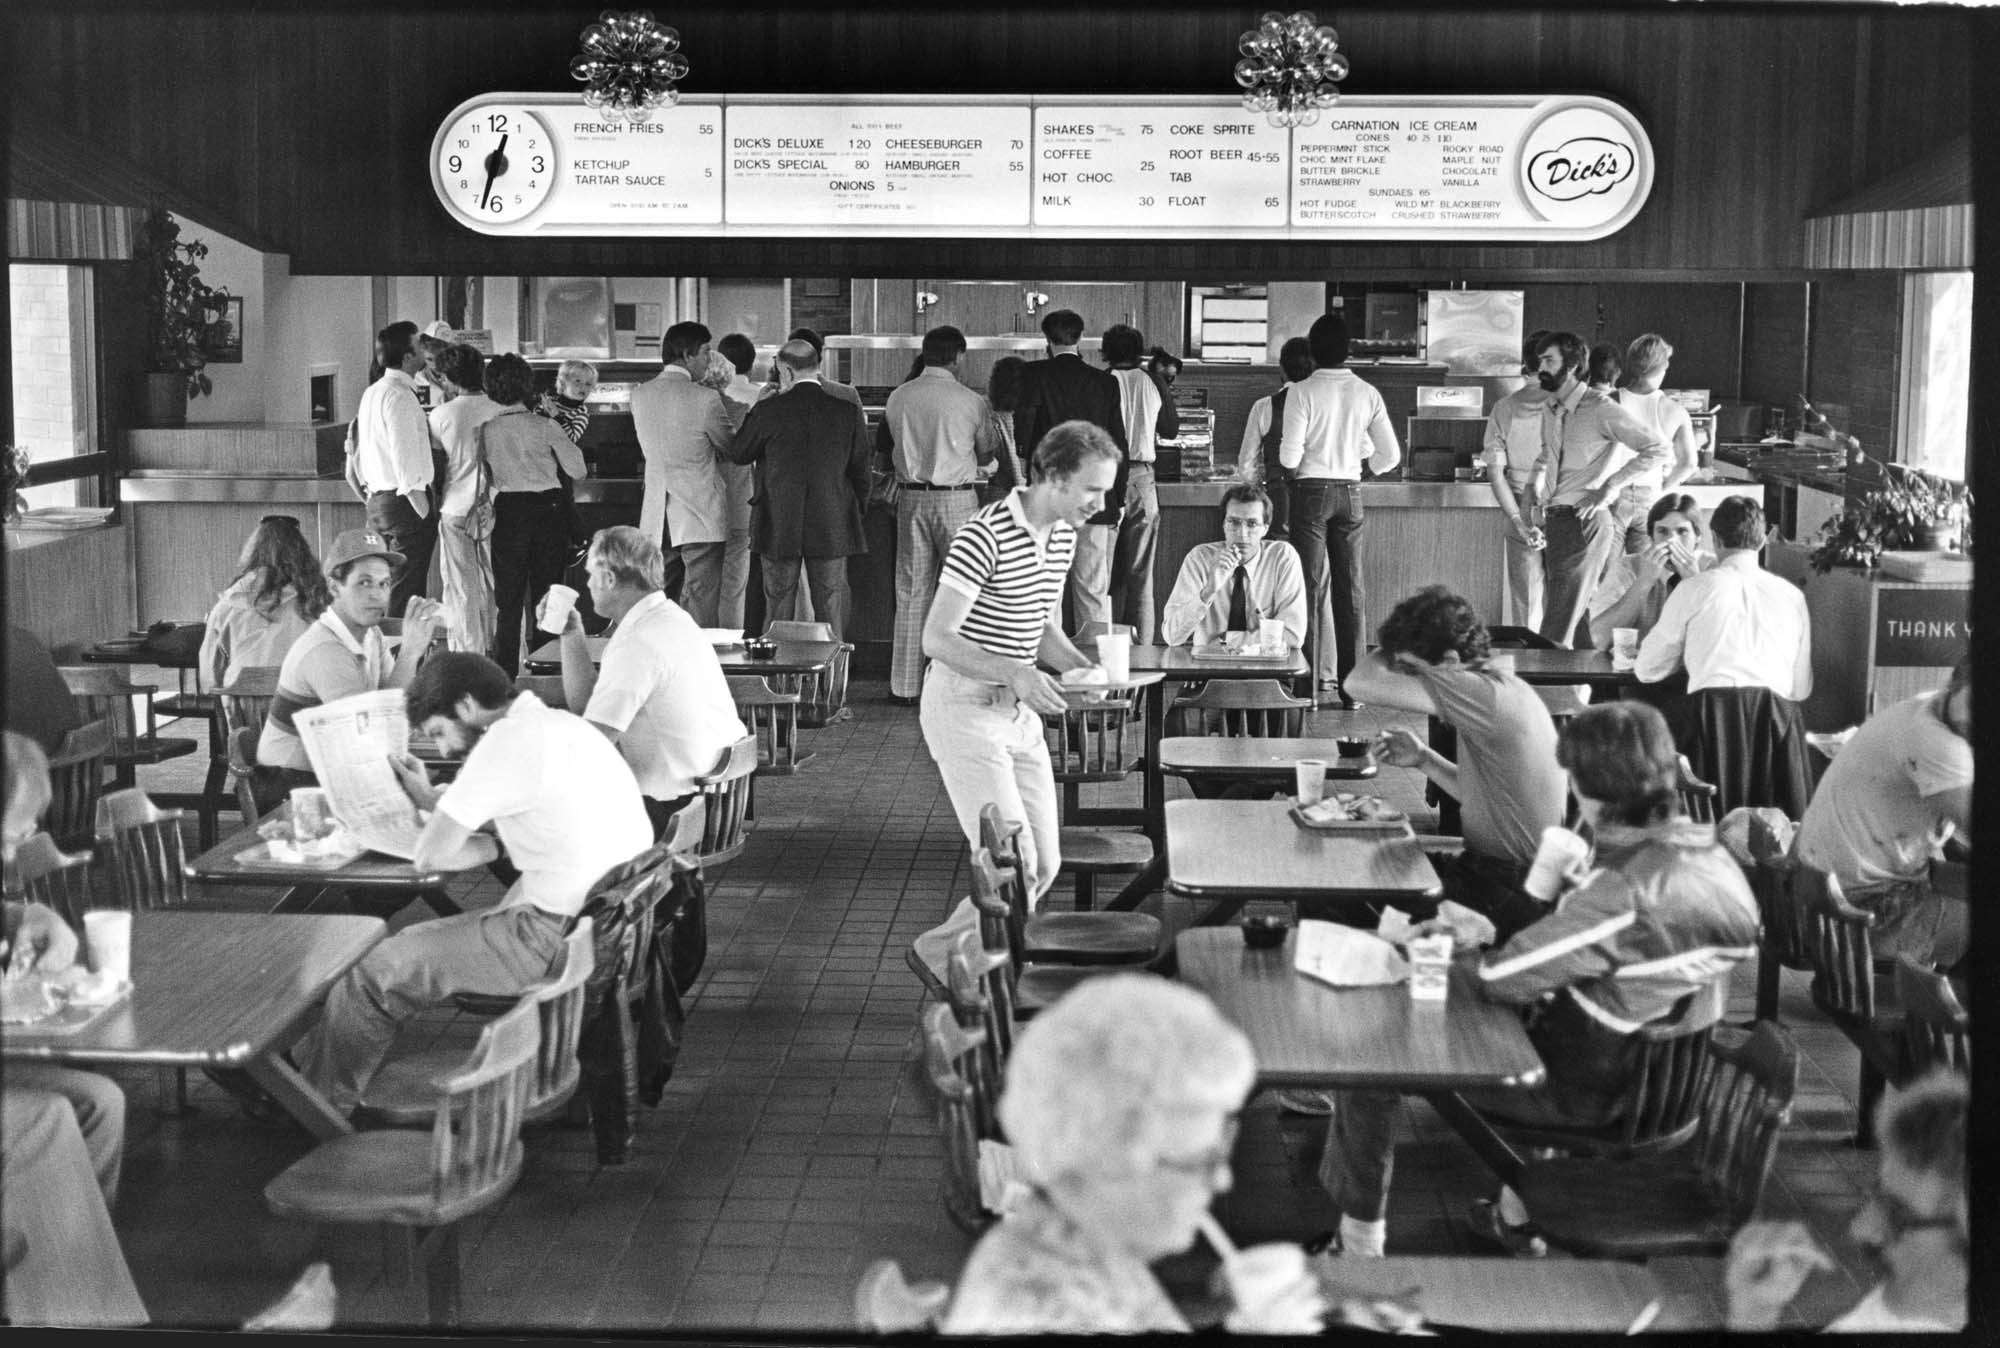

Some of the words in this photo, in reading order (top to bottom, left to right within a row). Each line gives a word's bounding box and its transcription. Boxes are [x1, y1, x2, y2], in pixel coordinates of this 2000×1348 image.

[471, 123, 481, 134] 11
[487, 114, 508, 133] 12
[517, 123, 521, 134] 1
[574, 122, 622, 134] FRENCH
[629, 122, 665, 134] FRIES
[699, 124, 713, 135] 55
[1331, 120, 1400, 131] CARNATION
[1409, 120, 1429, 131] ICE
[1433, 120, 1477, 131] CREAM
[1043, 124, 1095, 135] SHAKES
[1140, 124, 1154, 135] 75
[1169, 124, 1204, 135] COKE
[1213, 124, 1255, 135] SPRITE
[734, 137, 771, 149] DICK'S
[777, 138, 824, 149] DELUXE
[1355, 133, 1390, 142] CONES
[458, 139, 470, 149] 10
[528, 139, 536, 149] 2
[885, 139, 983, 149] CHEESEBURGER
[1010, 140, 1024, 150] 70
[1300, 144, 1357, 153] PEPPERMINT
[1363, 145, 1391, 153] STICK
[1442, 145, 1473, 153] ROCKY
[1479, 145, 1504, 153] ROAD
[1043, 149, 1092, 160] COFFEE
[1169, 149, 1202, 160] ROOT
[1210, 149, 1243, 160] BEER
[1299, 155, 1326, 164] CHOC
[1330, 155, 1353, 164] MINT
[1356, 155, 1386, 164] FLAKE
[1442, 156, 1474, 164] MAPLE
[1481, 156, 1502, 164] NUT
[449, 155, 462, 173] 9
[531, 155, 545, 173] 3
[574, 159, 630, 170] KETCHUP
[734, 158, 771, 170] DICK'S
[777, 159, 828, 170] SPECIAL
[885, 160, 961, 171] HAMBURGER
[1009, 161, 1024, 172] 55
[1140, 160, 1155, 171] 25
[1547, 152, 1618, 186] Dick's
[704, 168, 712, 178] 5
[1300, 167, 1336, 175] BUTTER
[1341, 167, 1381, 175] BRICKLE
[1442, 167, 1498, 175] CHOCOLATE
[575, 175, 620, 185] TARTAR
[625, 175, 666, 186] SAUCE
[1042, 172, 1068, 183] HOT
[1169, 172, 1192, 183] TAB
[1299, 178, 1361, 186] STRAWBERRY
[1442, 178, 1480, 186] VANILLA
[460, 179, 468, 189] 8
[528, 180, 536, 189] 4
[829, 180, 876, 191] ONIONS
[887, 181, 895, 191] 5
[1368, 188, 1413, 197] SUNDAES
[472, 194, 479, 204] 7
[490, 195, 503, 213] 6
[514, 194, 522, 204] 5
[1042, 195, 1072, 206] MILK
[1139, 196, 1155, 207] 30
[1168, 196, 1207, 207] FLOAT
[1264, 197, 1280, 208] 65
[1300, 200, 1319, 208] HOT
[1324, 200, 1357, 208] FUDGE
[1394, 200, 1418, 208] WILD
[1440, 200, 1501, 208] BLACKBERRY
[1300, 211, 1376, 219] BUTTERSCOTCH
[1391, 211, 1435, 220] CRUSHED
[1440, 211, 1501, 220] STRAWBERRY
[365, 535, 378, 545] H
[1887, 620, 1956, 638] THANK
